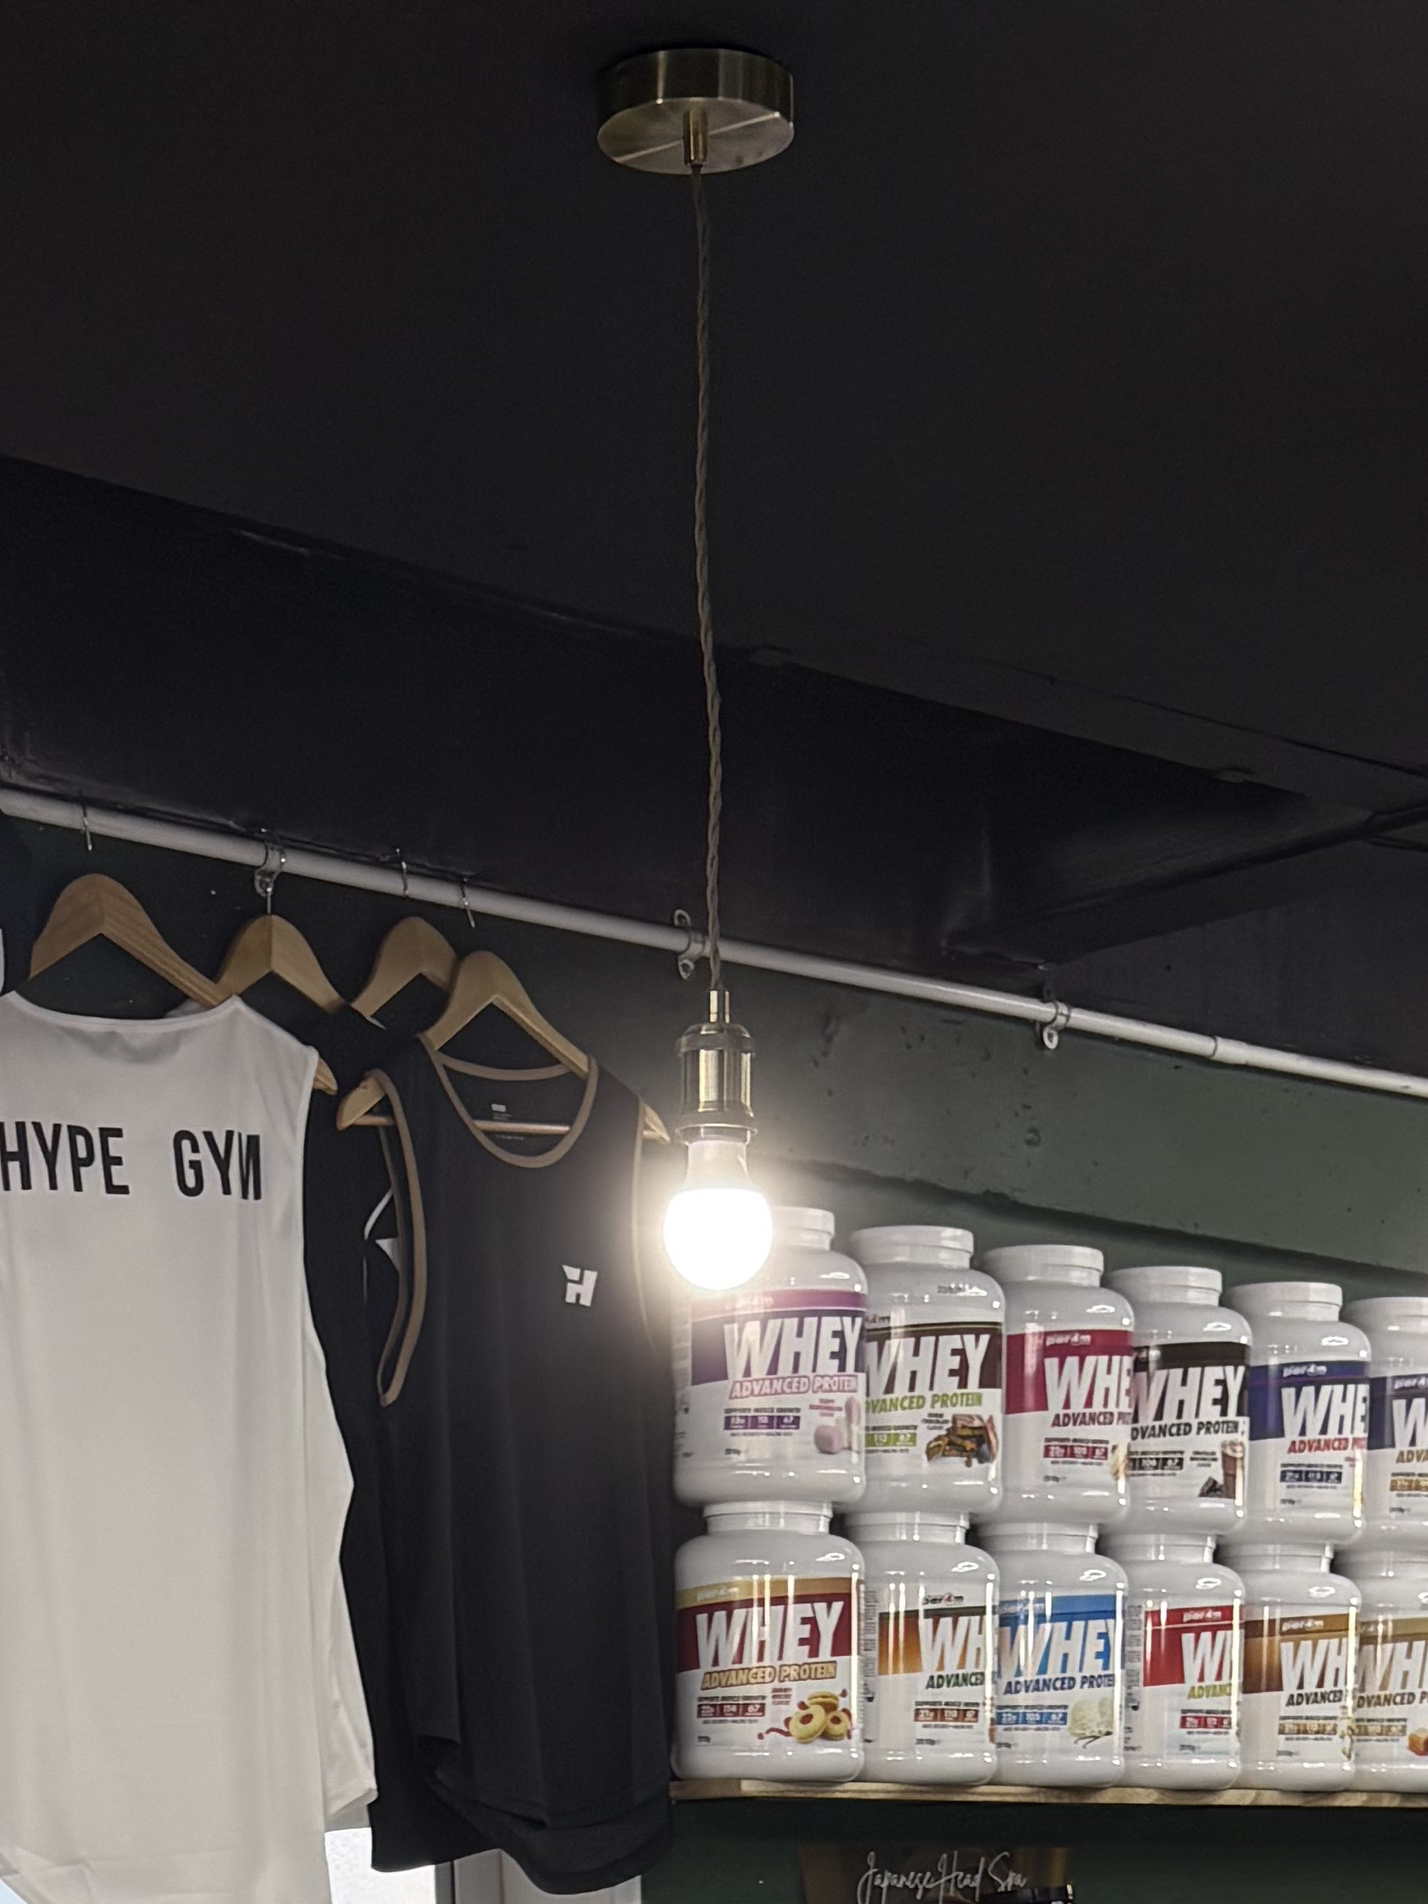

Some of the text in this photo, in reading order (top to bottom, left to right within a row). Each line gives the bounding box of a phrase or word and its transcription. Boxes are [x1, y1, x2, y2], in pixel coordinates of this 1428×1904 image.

[723, 1315, 863, 1382] WHEY
[729, 1375, 858, 1399] ADVANCED PROTEIN
[1044, 1356, 1132, 1411] WHE
[866, 1392, 983, 1413] DVANCED PROTEIN
[1282, 1384, 1369, 1438] WHE
[1051, 1412, 1114, 1427] ADVANCED
[1131, 1421, 1239, 1441] DVANCED PROTEIN
[1288, 1438, 1348, 1454] ADVANCED
[696, 1601, 844, 1669] WHEY
[920, 1616, 987, 1674] WH
[701, 1661, 837, 1690] ADVANCED PROTEIN
[1280, 1638, 1348, 1692] WH
[1004, 1673, 1115, 1695] ADVANCED PROTE
[1357, 1692, 1416, 1708] DVANCED
